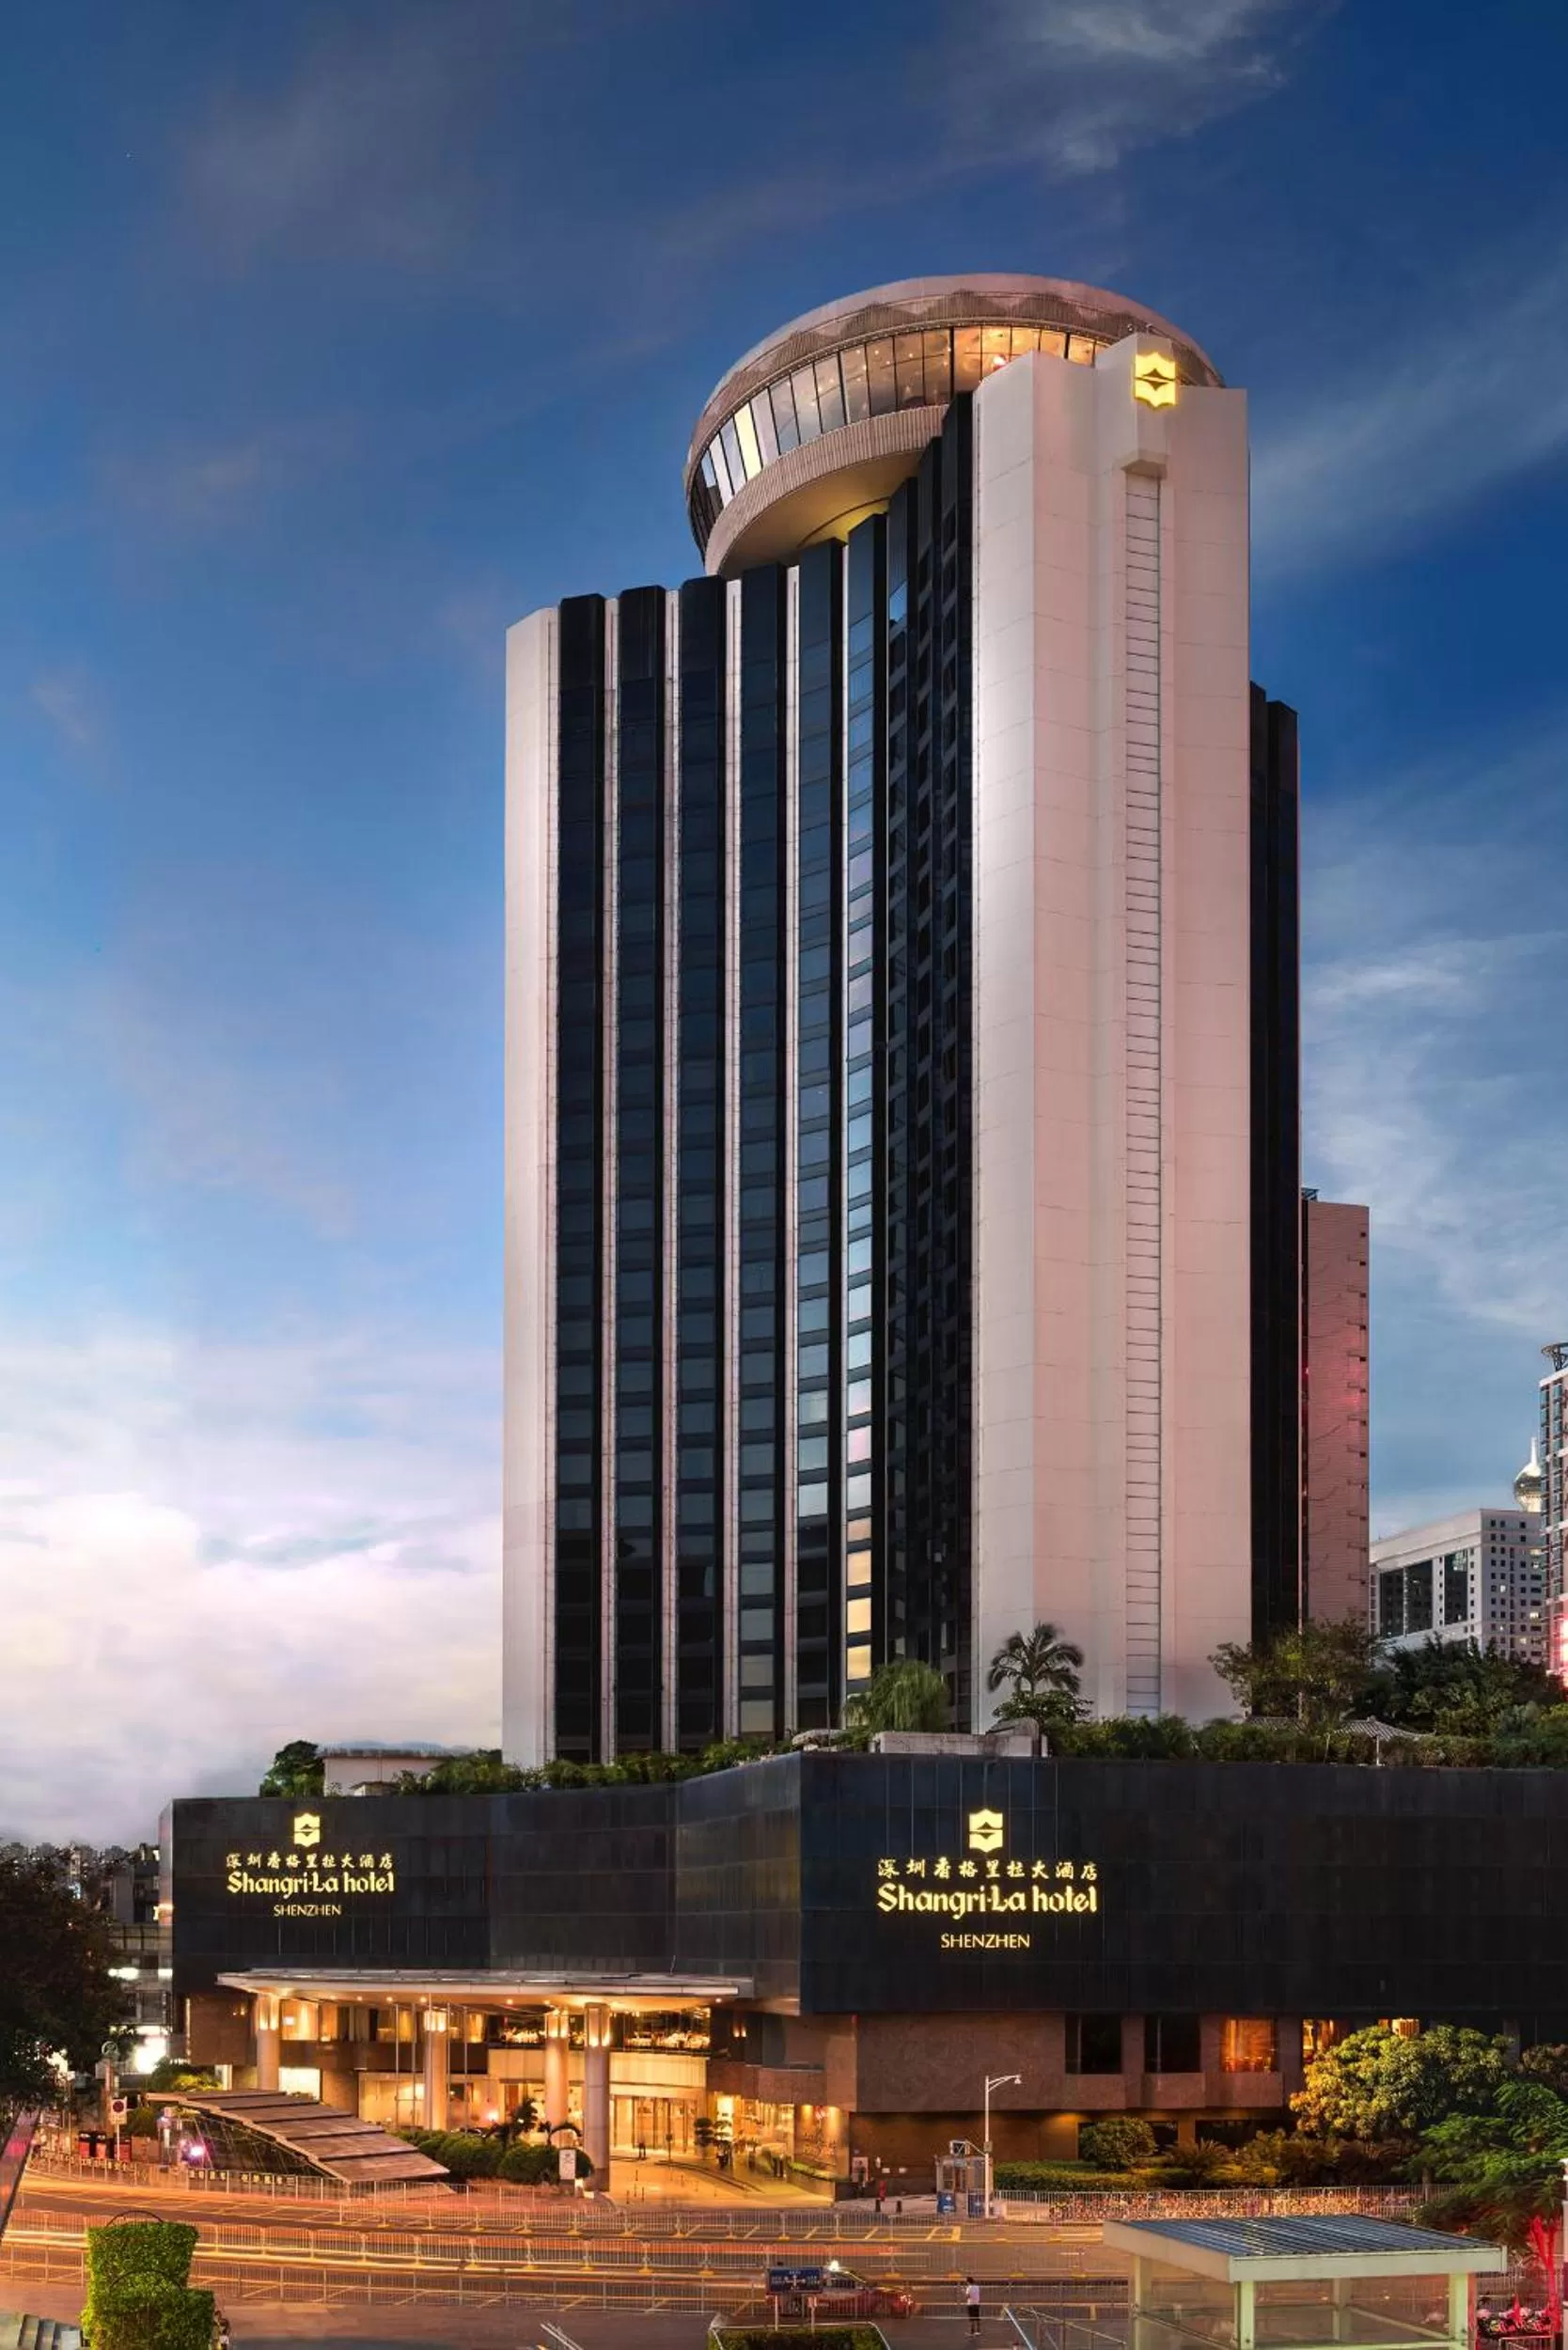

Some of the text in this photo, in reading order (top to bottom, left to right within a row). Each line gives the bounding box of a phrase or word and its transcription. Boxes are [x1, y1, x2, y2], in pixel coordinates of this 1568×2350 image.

[226, 1851, 393, 1870] 深圳香格里拉大酒店
[877, 1856, 1098, 1881] 深圳香格里拉大酒店
[343, 1871, 395, 1893] hotel
[1031, 1884, 1098, 1913] hotel
[273, 1904, 341, 1917] SHENZHEN
[940, 1933, 1030, 1949] SHENZHEN
